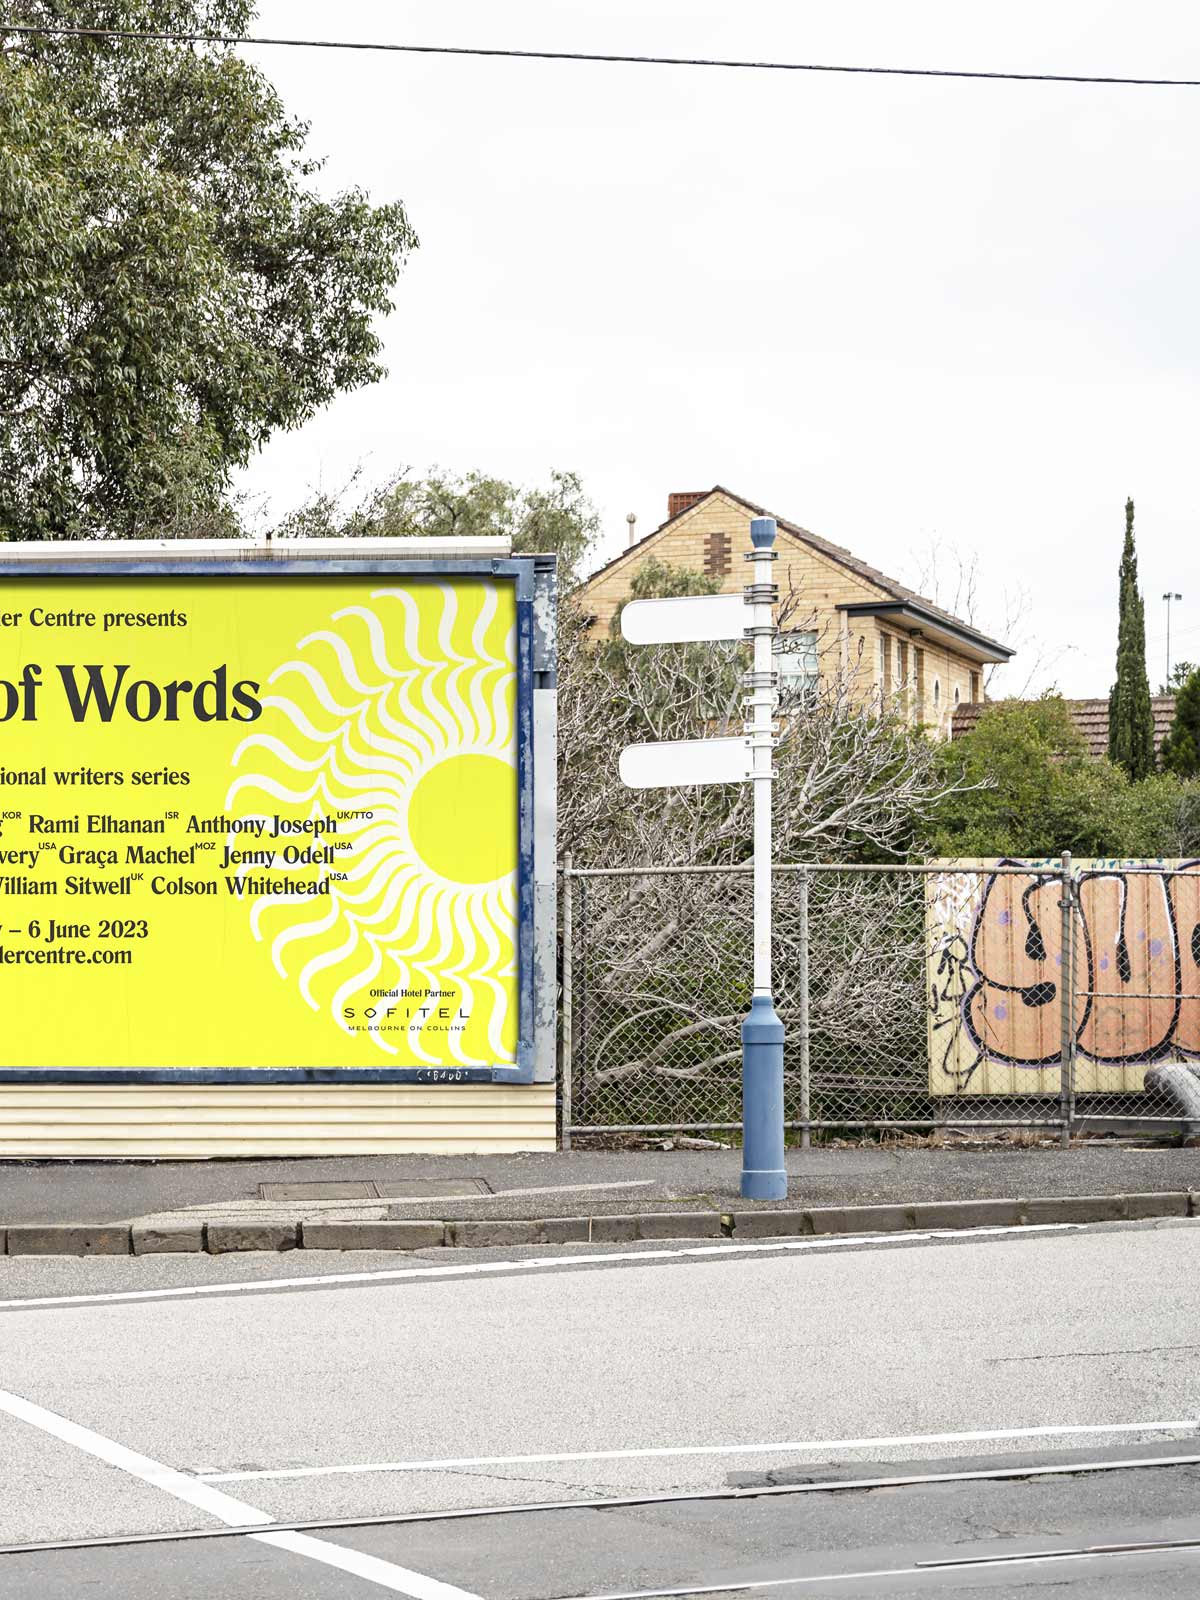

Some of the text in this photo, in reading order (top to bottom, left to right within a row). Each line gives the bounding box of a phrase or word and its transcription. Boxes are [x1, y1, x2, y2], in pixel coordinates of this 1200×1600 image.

[30, 608, 96, 626] Centre
[104, 609, 187, 631] presents
[56, 664, 262, 722] Words
[54, 767, 124, 785] writers
[132, 767, 190, 785] series
[29, 815, 79, 833] Rami
[186, 815, 265, 838] Anthony
[59, 846, 118, 869] Graça
[219, 846, 276, 869] Jenny
[151, 876, 217, 895] Colson
[29, 920, 40, 938] 6
[46, 920, 90, 942] June
[98, 920, 148, 938] 2023
[370, 989, 455, 997] Official Hotel Partner
[345, 1008, 469, 1018] SOFITEL
